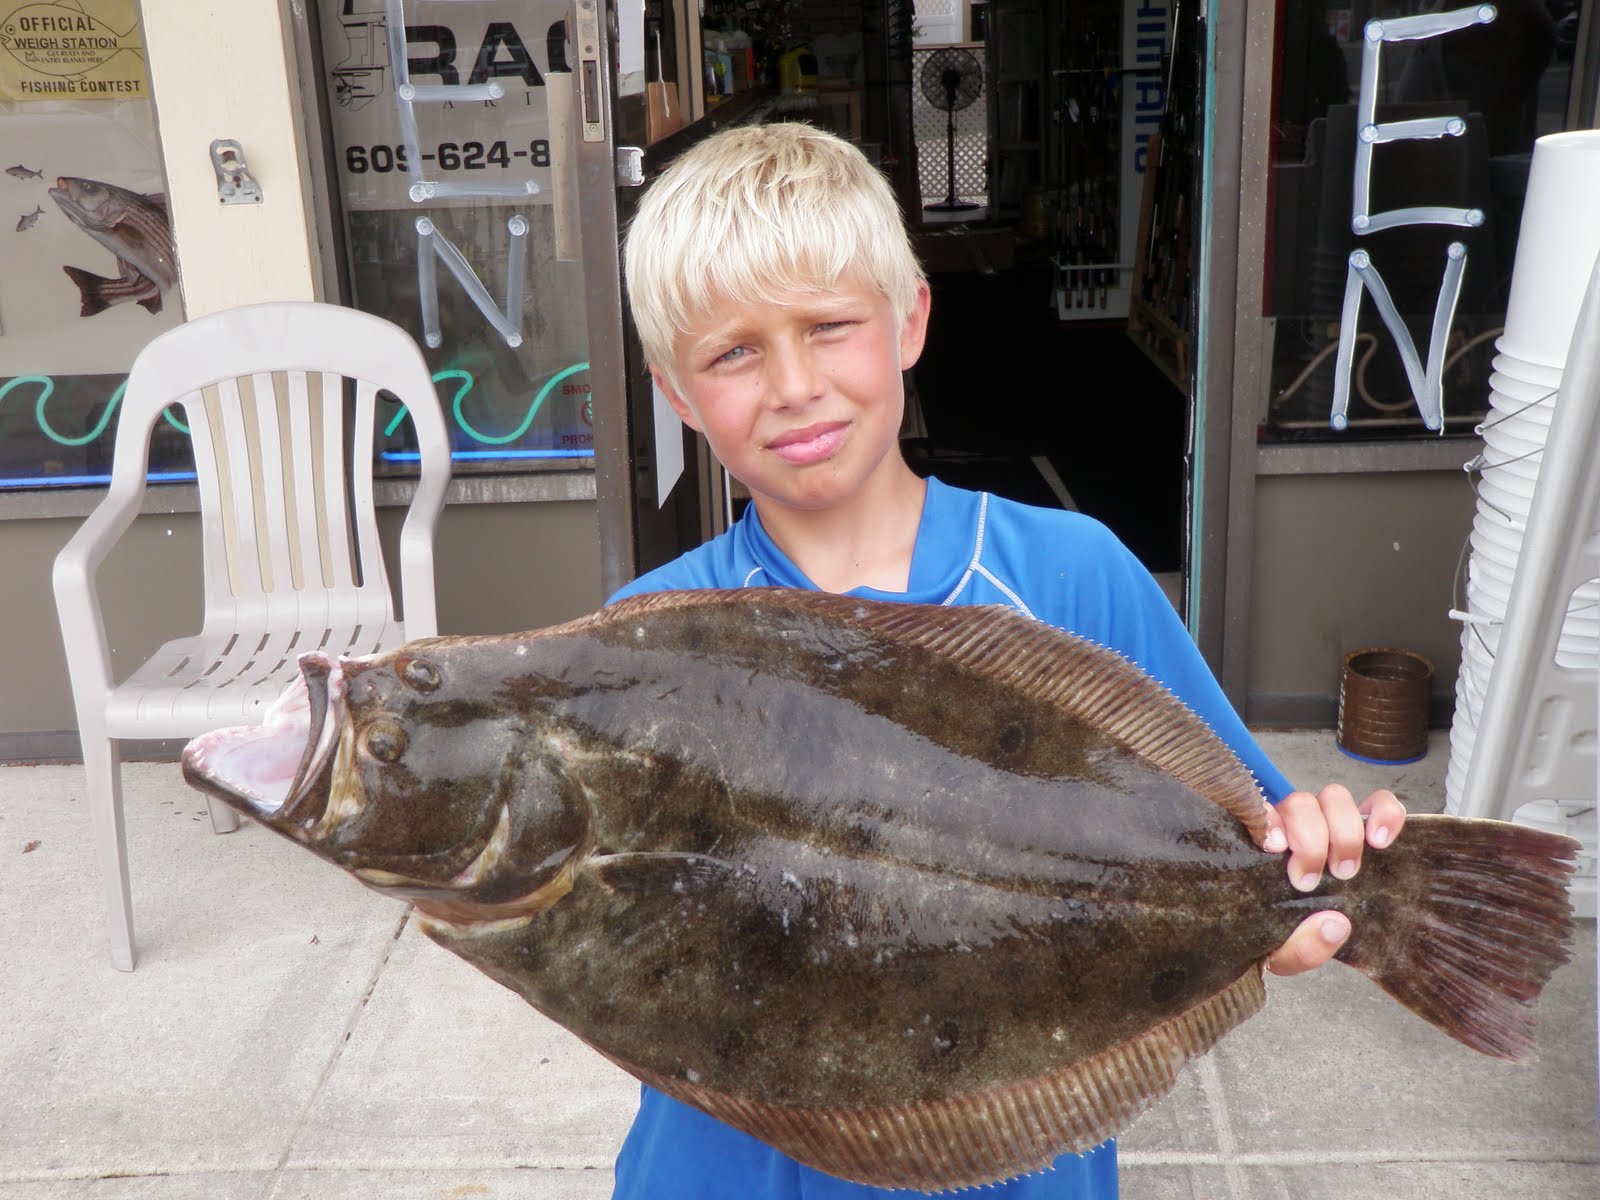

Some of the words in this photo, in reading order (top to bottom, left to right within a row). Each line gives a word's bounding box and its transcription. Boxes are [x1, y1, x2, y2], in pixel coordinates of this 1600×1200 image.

[20, 17, 96, 32] OFFICIAL
[14, 38, 58, 49] WEIGH
[62, 37, 118, 49] STATION
[21, 82, 76, 93] FISHING
[80, 80, 141, 92] CONTEST
[1331, 3, 1498, 436] EN
